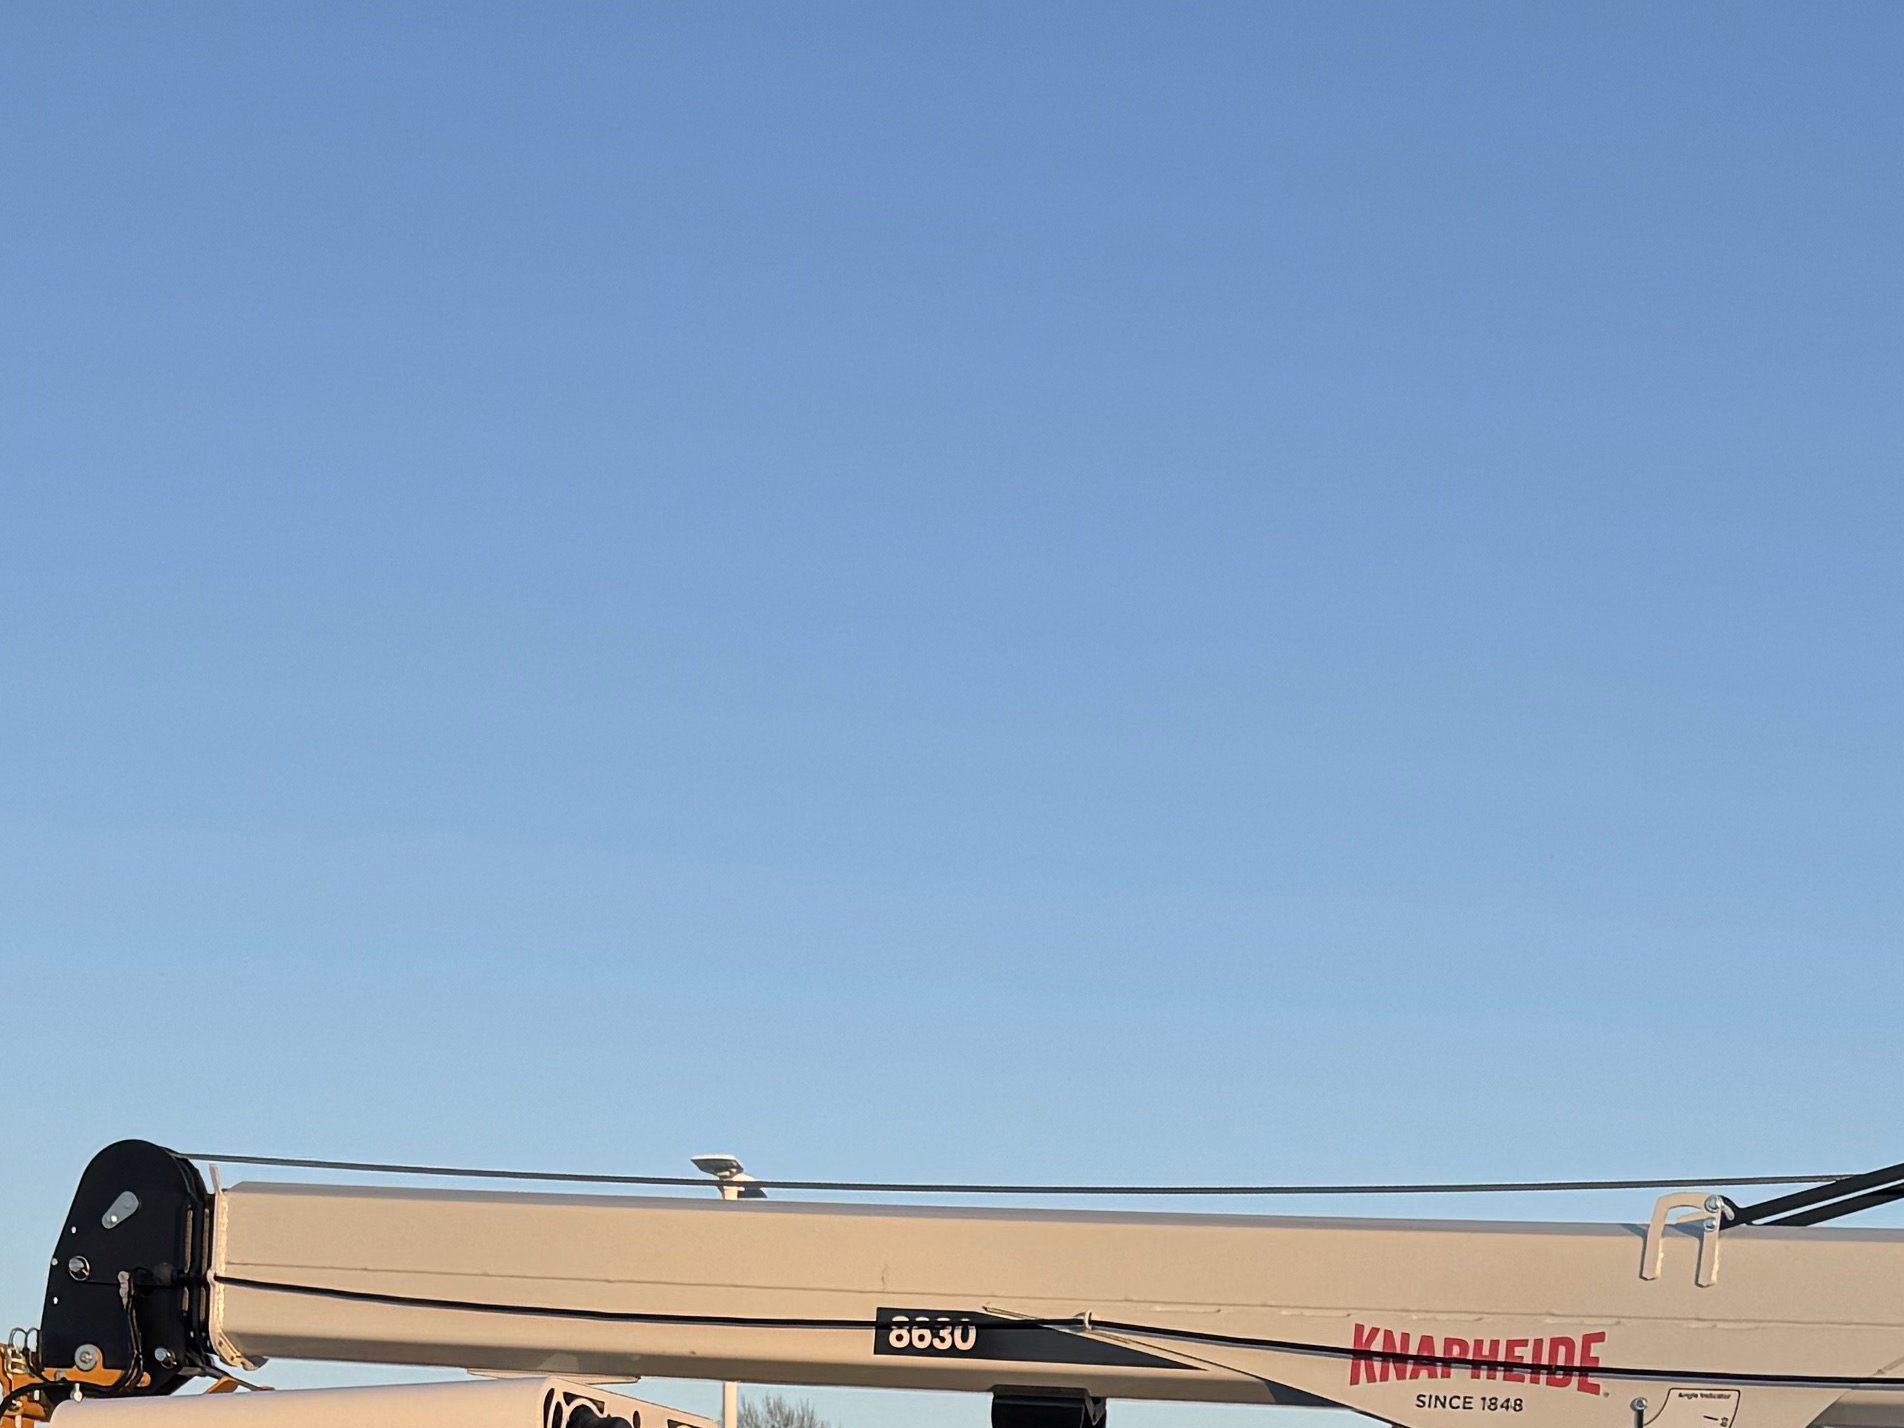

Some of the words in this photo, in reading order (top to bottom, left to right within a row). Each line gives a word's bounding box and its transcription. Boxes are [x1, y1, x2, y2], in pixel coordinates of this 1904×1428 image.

[889, 1316, 976, 1351] 8630
[1350, 1323, 1606, 1396] KNAPHEIDE
[1416, 1394, 1474, 1410] SINCE
[1480, 1396, 1524, 1412] 1848
